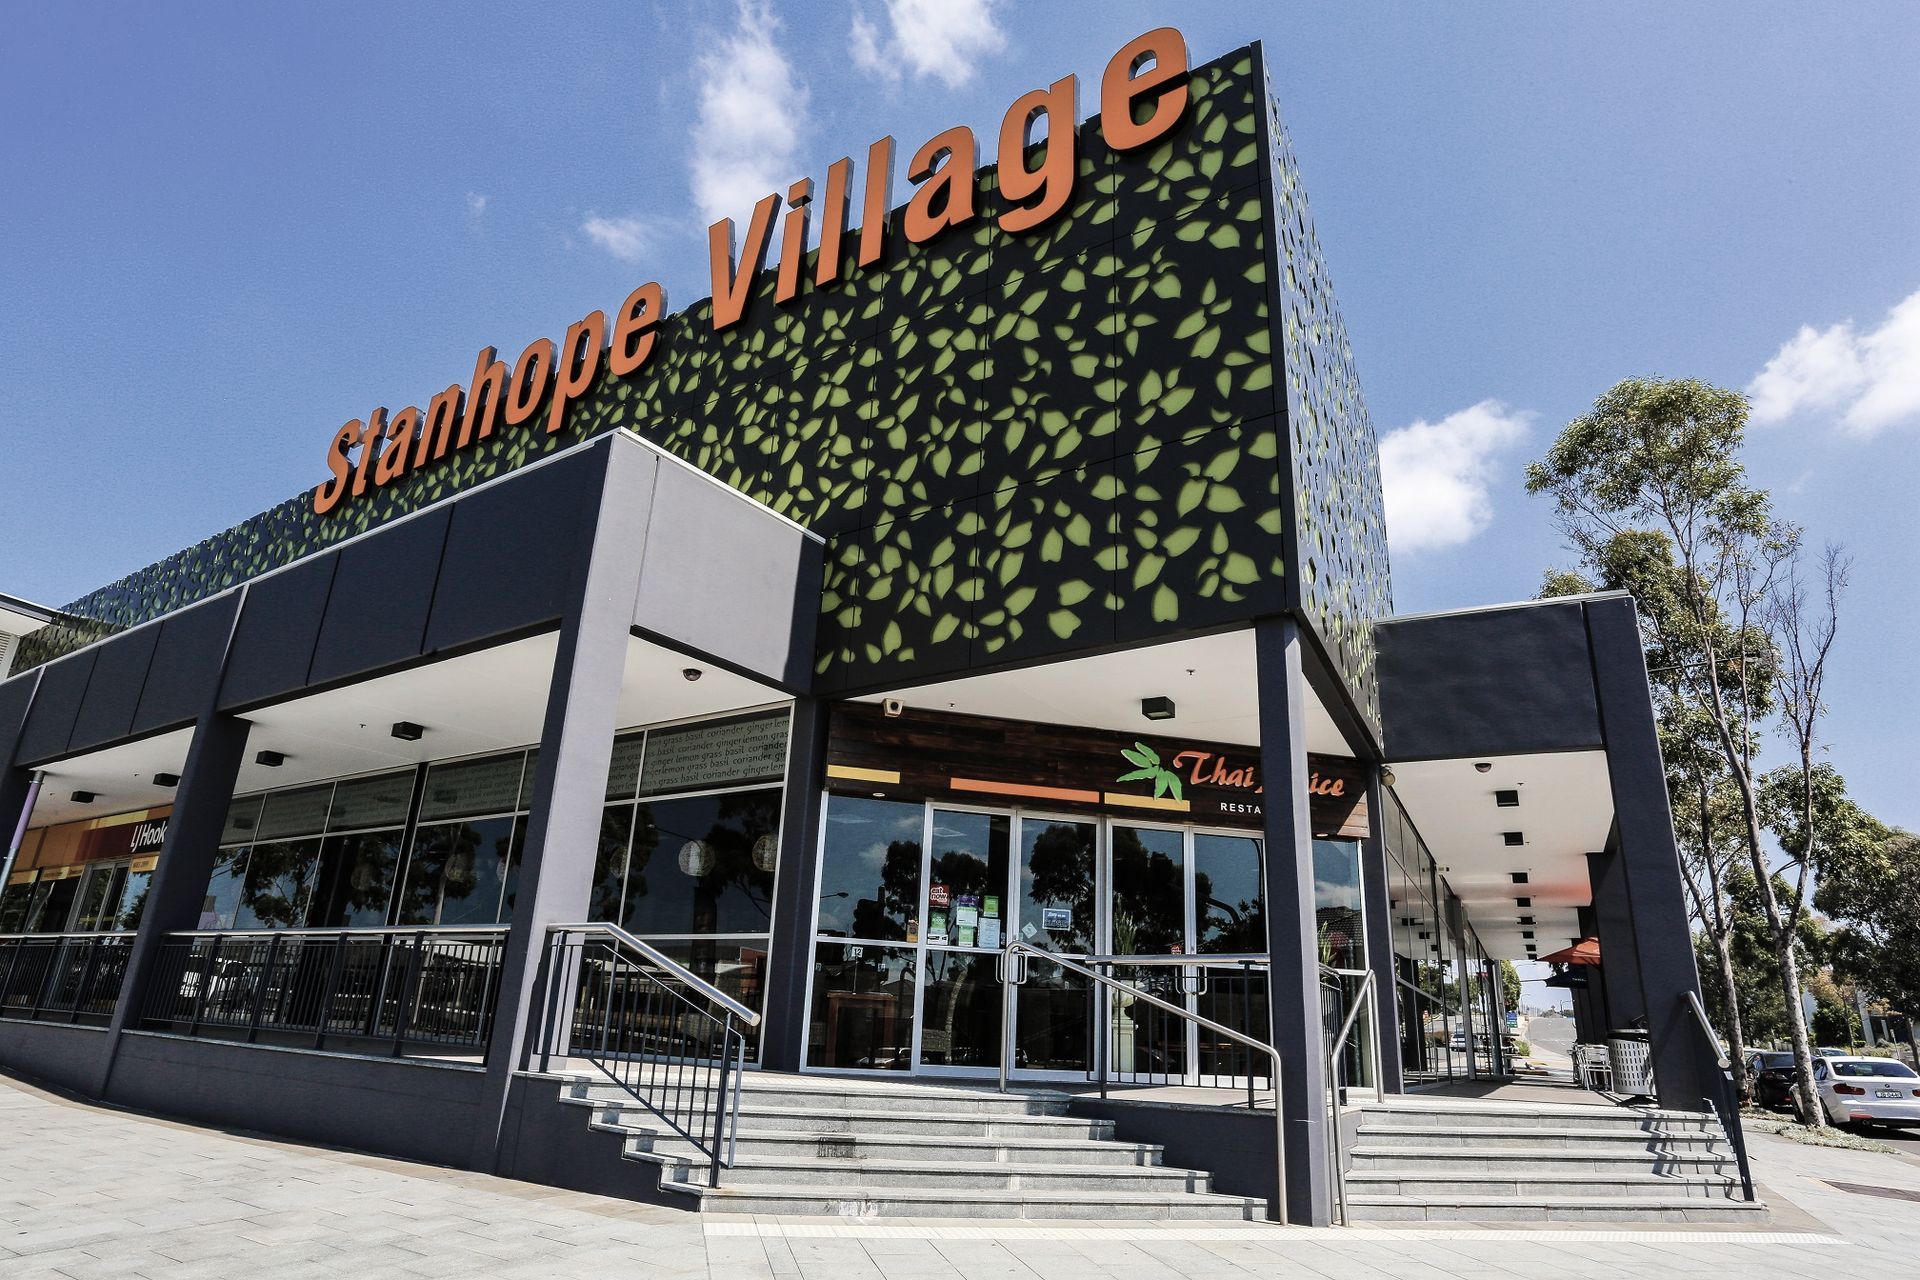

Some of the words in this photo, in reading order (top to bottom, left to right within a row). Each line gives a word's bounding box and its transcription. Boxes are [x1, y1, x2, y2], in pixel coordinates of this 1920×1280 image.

[313, 282, 667, 516] Stanhope
[708, 26, 1191, 331] Village
[774, 717, 790, 728] lem
[770, 731, 788, 741] gras
[770, 761, 785, 772] lem
[1173, 751, 1256, 788] Thai
[1220, 802, 1262, 815] RESTA
[138, 820, 169, 847] Hook
